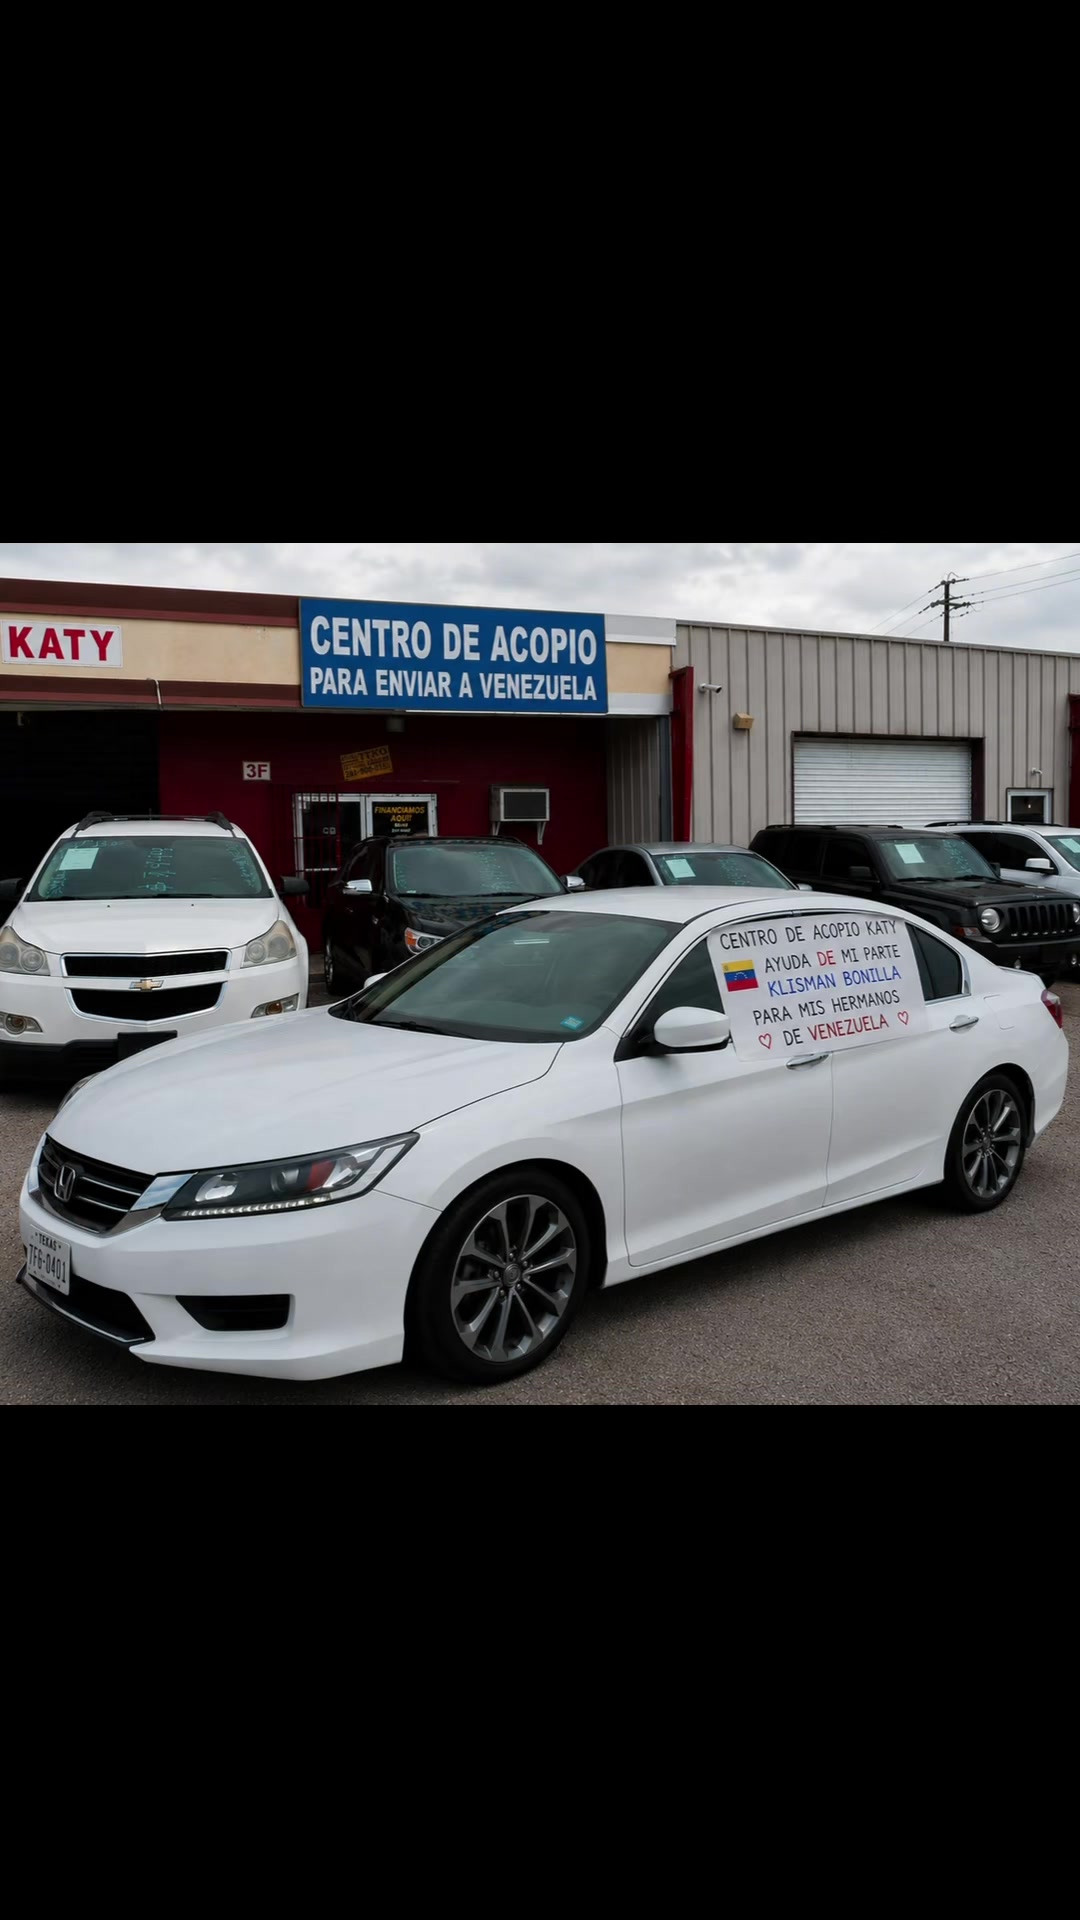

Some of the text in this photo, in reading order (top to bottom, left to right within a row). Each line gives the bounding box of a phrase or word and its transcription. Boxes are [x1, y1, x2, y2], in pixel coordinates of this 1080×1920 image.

[8, 625, 115, 661] KATY
[310, 615, 598, 665] CENTRO DE ACOPIO
[310, 667, 598, 701] PARA ENVIAR A VENEZUELA
[246, 763, 268, 778] 3F
[374, 806, 425, 814] FINANCIAMOS
[719, 920, 897, 950] CENTRO DE ACOPIO KATY
[765, 944, 901, 974] AYUDA DE MI PARTE
[767, 965, 902, 997] KLISMAN BONILLA
[752, 989, 901, 1026] PARA MIS HERMANOS
[783, 1013, 889, 1047] DE VENEZUELA
[38, 1233, 57, 1252] TEXAS
